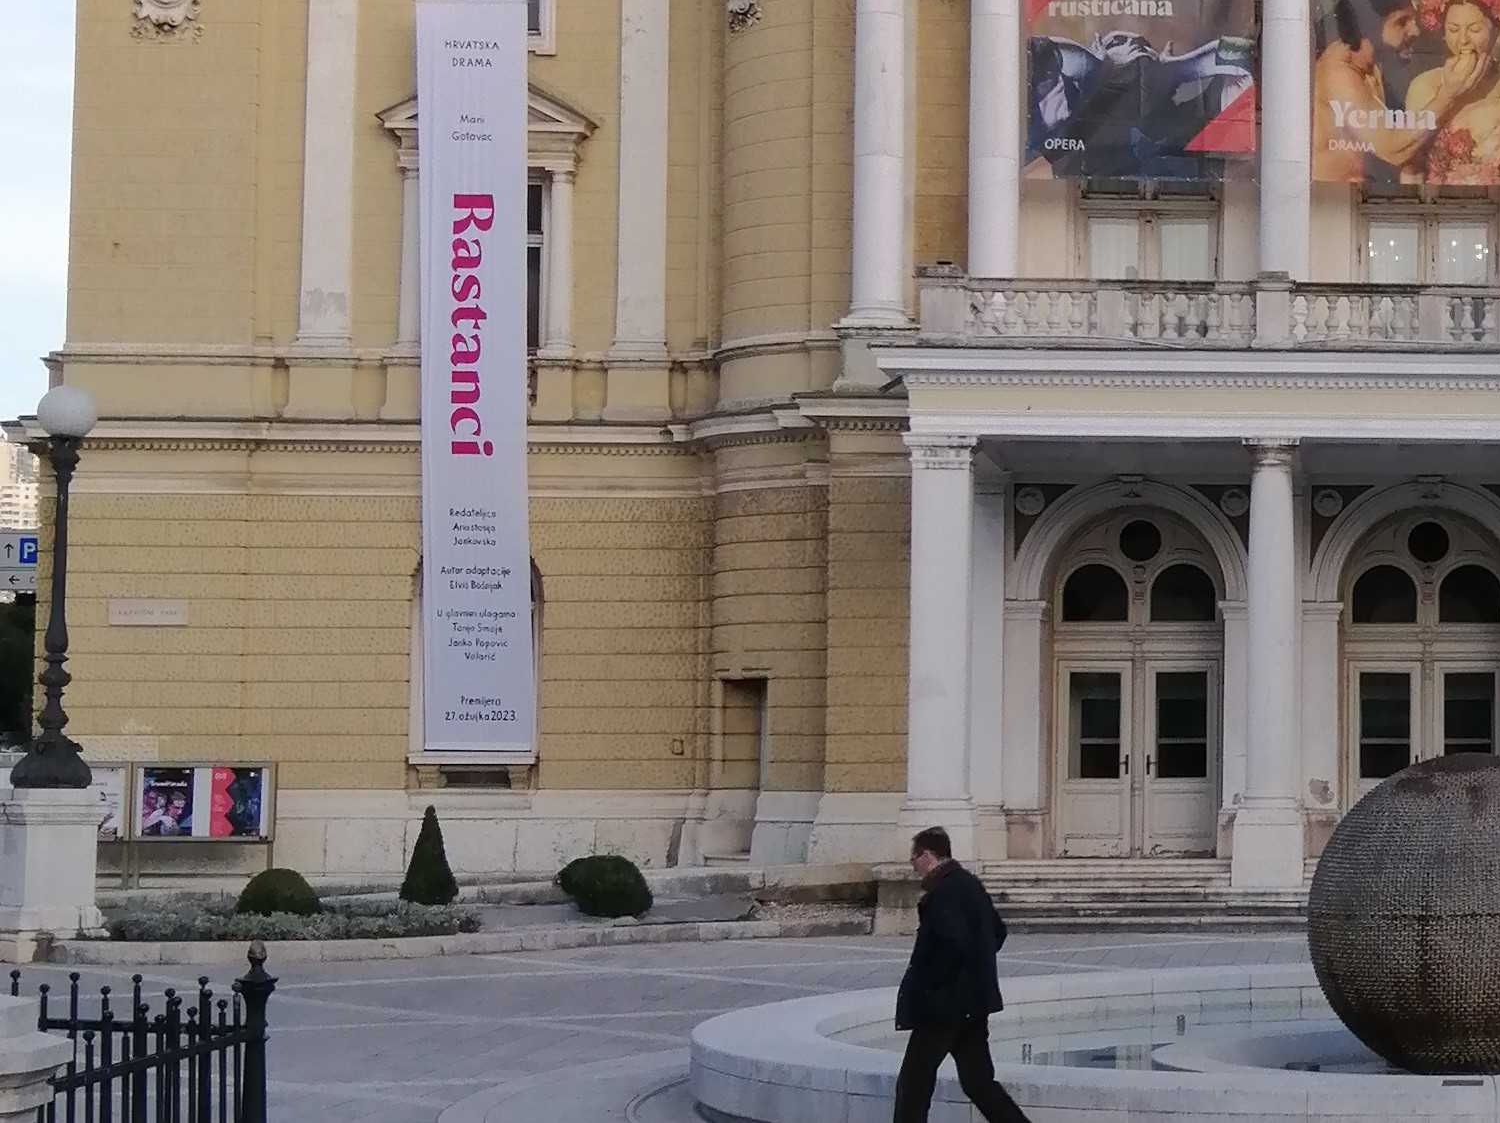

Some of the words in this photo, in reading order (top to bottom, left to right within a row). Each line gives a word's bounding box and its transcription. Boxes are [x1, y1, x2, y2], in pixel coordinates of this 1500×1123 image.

[444, 40, 500, 51] HRVATSKA
[452, 57, 493, 68] DRAMA
[1328, 99, 1438, 130] Yerma
[451, 131, 493, 142] Gotovac
[1044, 138, 1086, 151] OPERA
[1328, 139, 1376, 153] DRAMA
[450, 193, 496, 457] Rastanci
[23, 542, 35, 559] P
